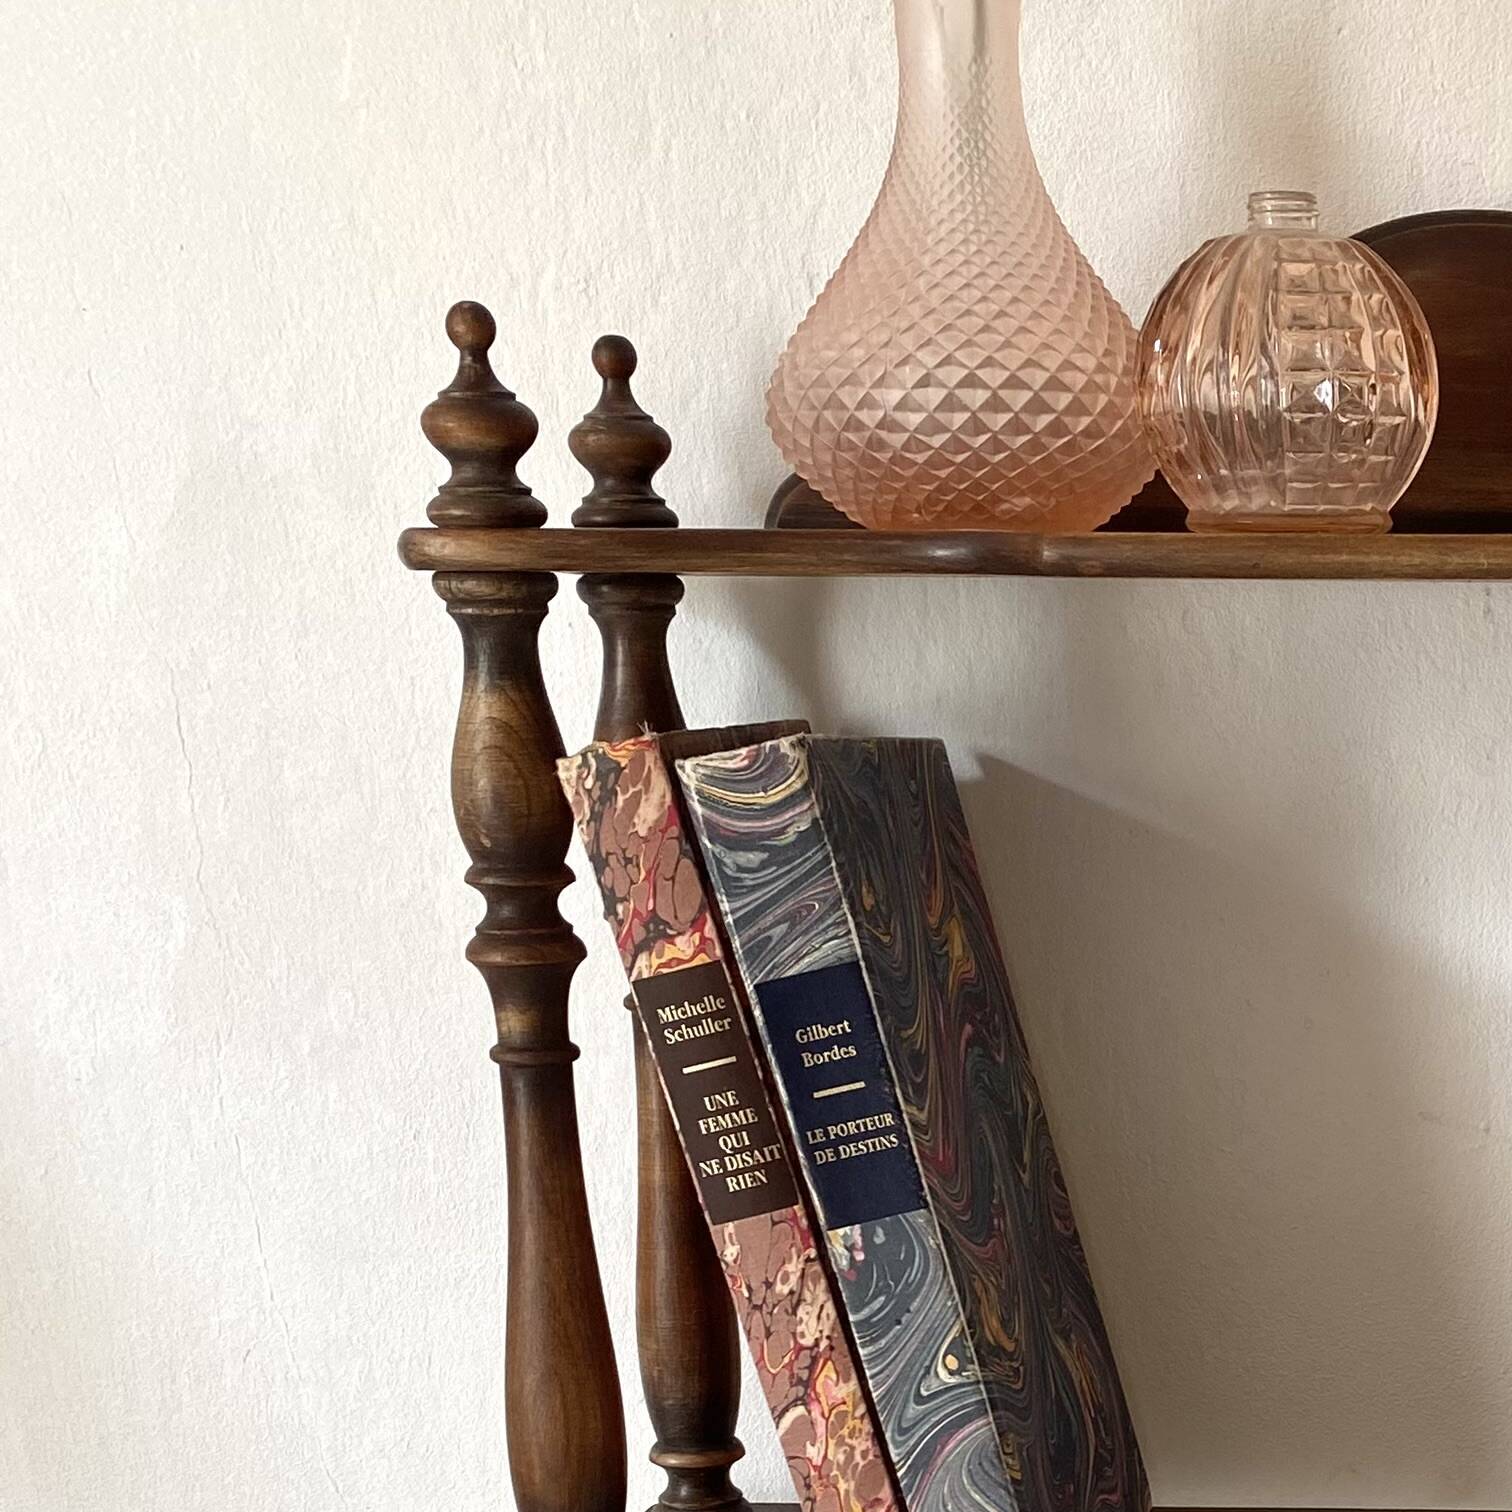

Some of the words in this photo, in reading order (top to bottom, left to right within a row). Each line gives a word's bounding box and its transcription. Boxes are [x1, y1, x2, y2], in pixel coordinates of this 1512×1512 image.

[656, 995, 726, 1024] Michelle
[664, 1017, 732, 1045] Schuller
[795, 1020, 852, 1044] Gilbert
[801, 1045, 857, 1068] Bordes
[703, 1090, 740, 1112] UNE
[698, 1107, 758, 1135] FEMME
[806, 1128, 826, 1145] LE
[827, 1112, 895, 1140] PORTEUR
[718, 1131, 751, 1154] QUI
[814, 1148, 837, 1165] DE
[839, 1133, 899, 1159] DESTINS
[699, 1158, 723, 1178] NE
[724, 1143, 781, 1171] DISAIT
[725, 1169, 768, 1193] RIEN
